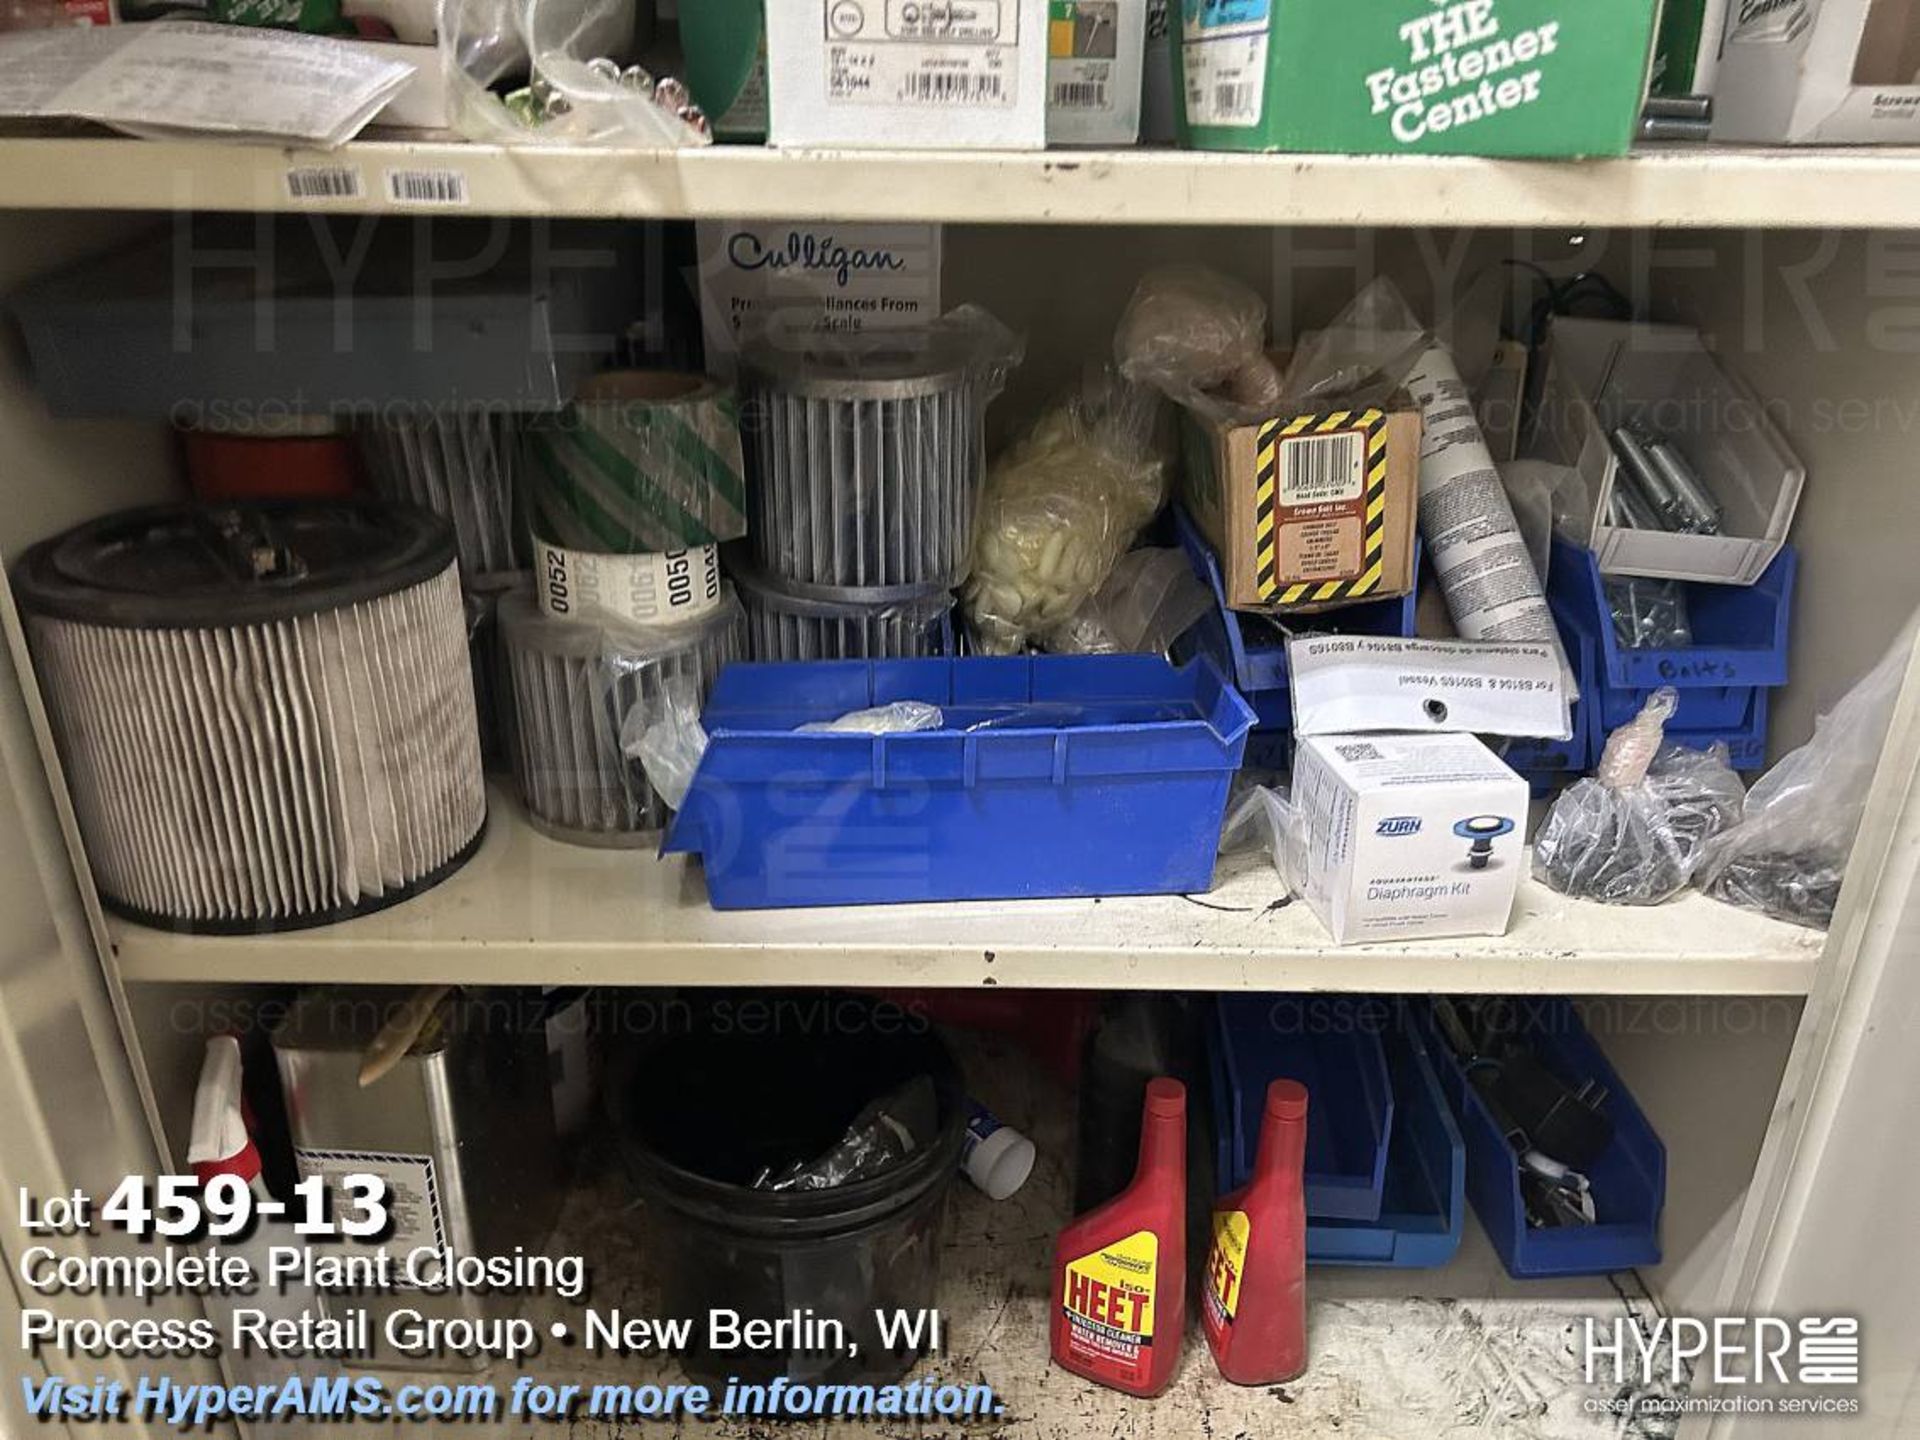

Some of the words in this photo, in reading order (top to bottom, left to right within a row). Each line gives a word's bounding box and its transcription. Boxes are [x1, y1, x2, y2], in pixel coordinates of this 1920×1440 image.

[1400, 0, 1499, 63] THE
[1366, 21, 1559, 115] Fastener
[1391, 69, 1542, 142] Center
[728, 232, 904, 286] Culligan
[881, 298, 918, 312] From
[547, 550, 569, 614] 0052
[1376, 817, 1422, 835] ZURN
[1367, 885, 1448, 902] Diaphragm
[1451, 882, 1471, 896] Kit
[1069, 1268, 1150, 1333] HEET
